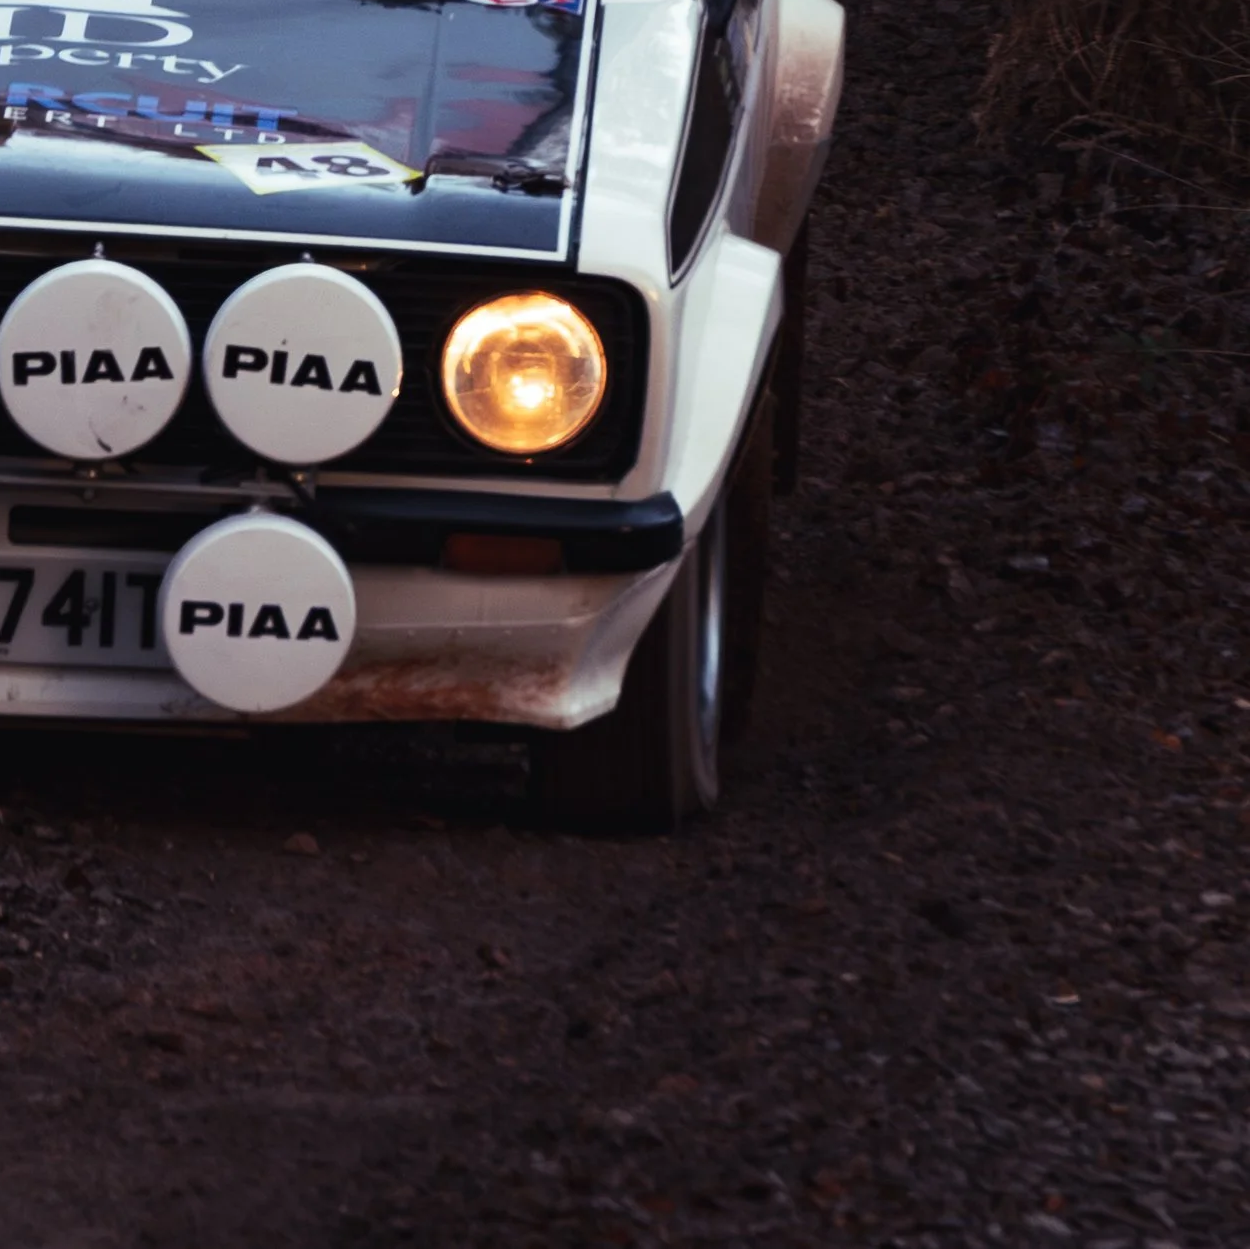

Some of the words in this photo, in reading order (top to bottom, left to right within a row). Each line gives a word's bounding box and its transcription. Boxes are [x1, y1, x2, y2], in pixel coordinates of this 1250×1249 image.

[174, 126, 286, 144] LTD
[11, 346, 175, 387] PIAA
[223, 344, 383, 396] PIAA
[178, 599, 340, 643] PIAA
